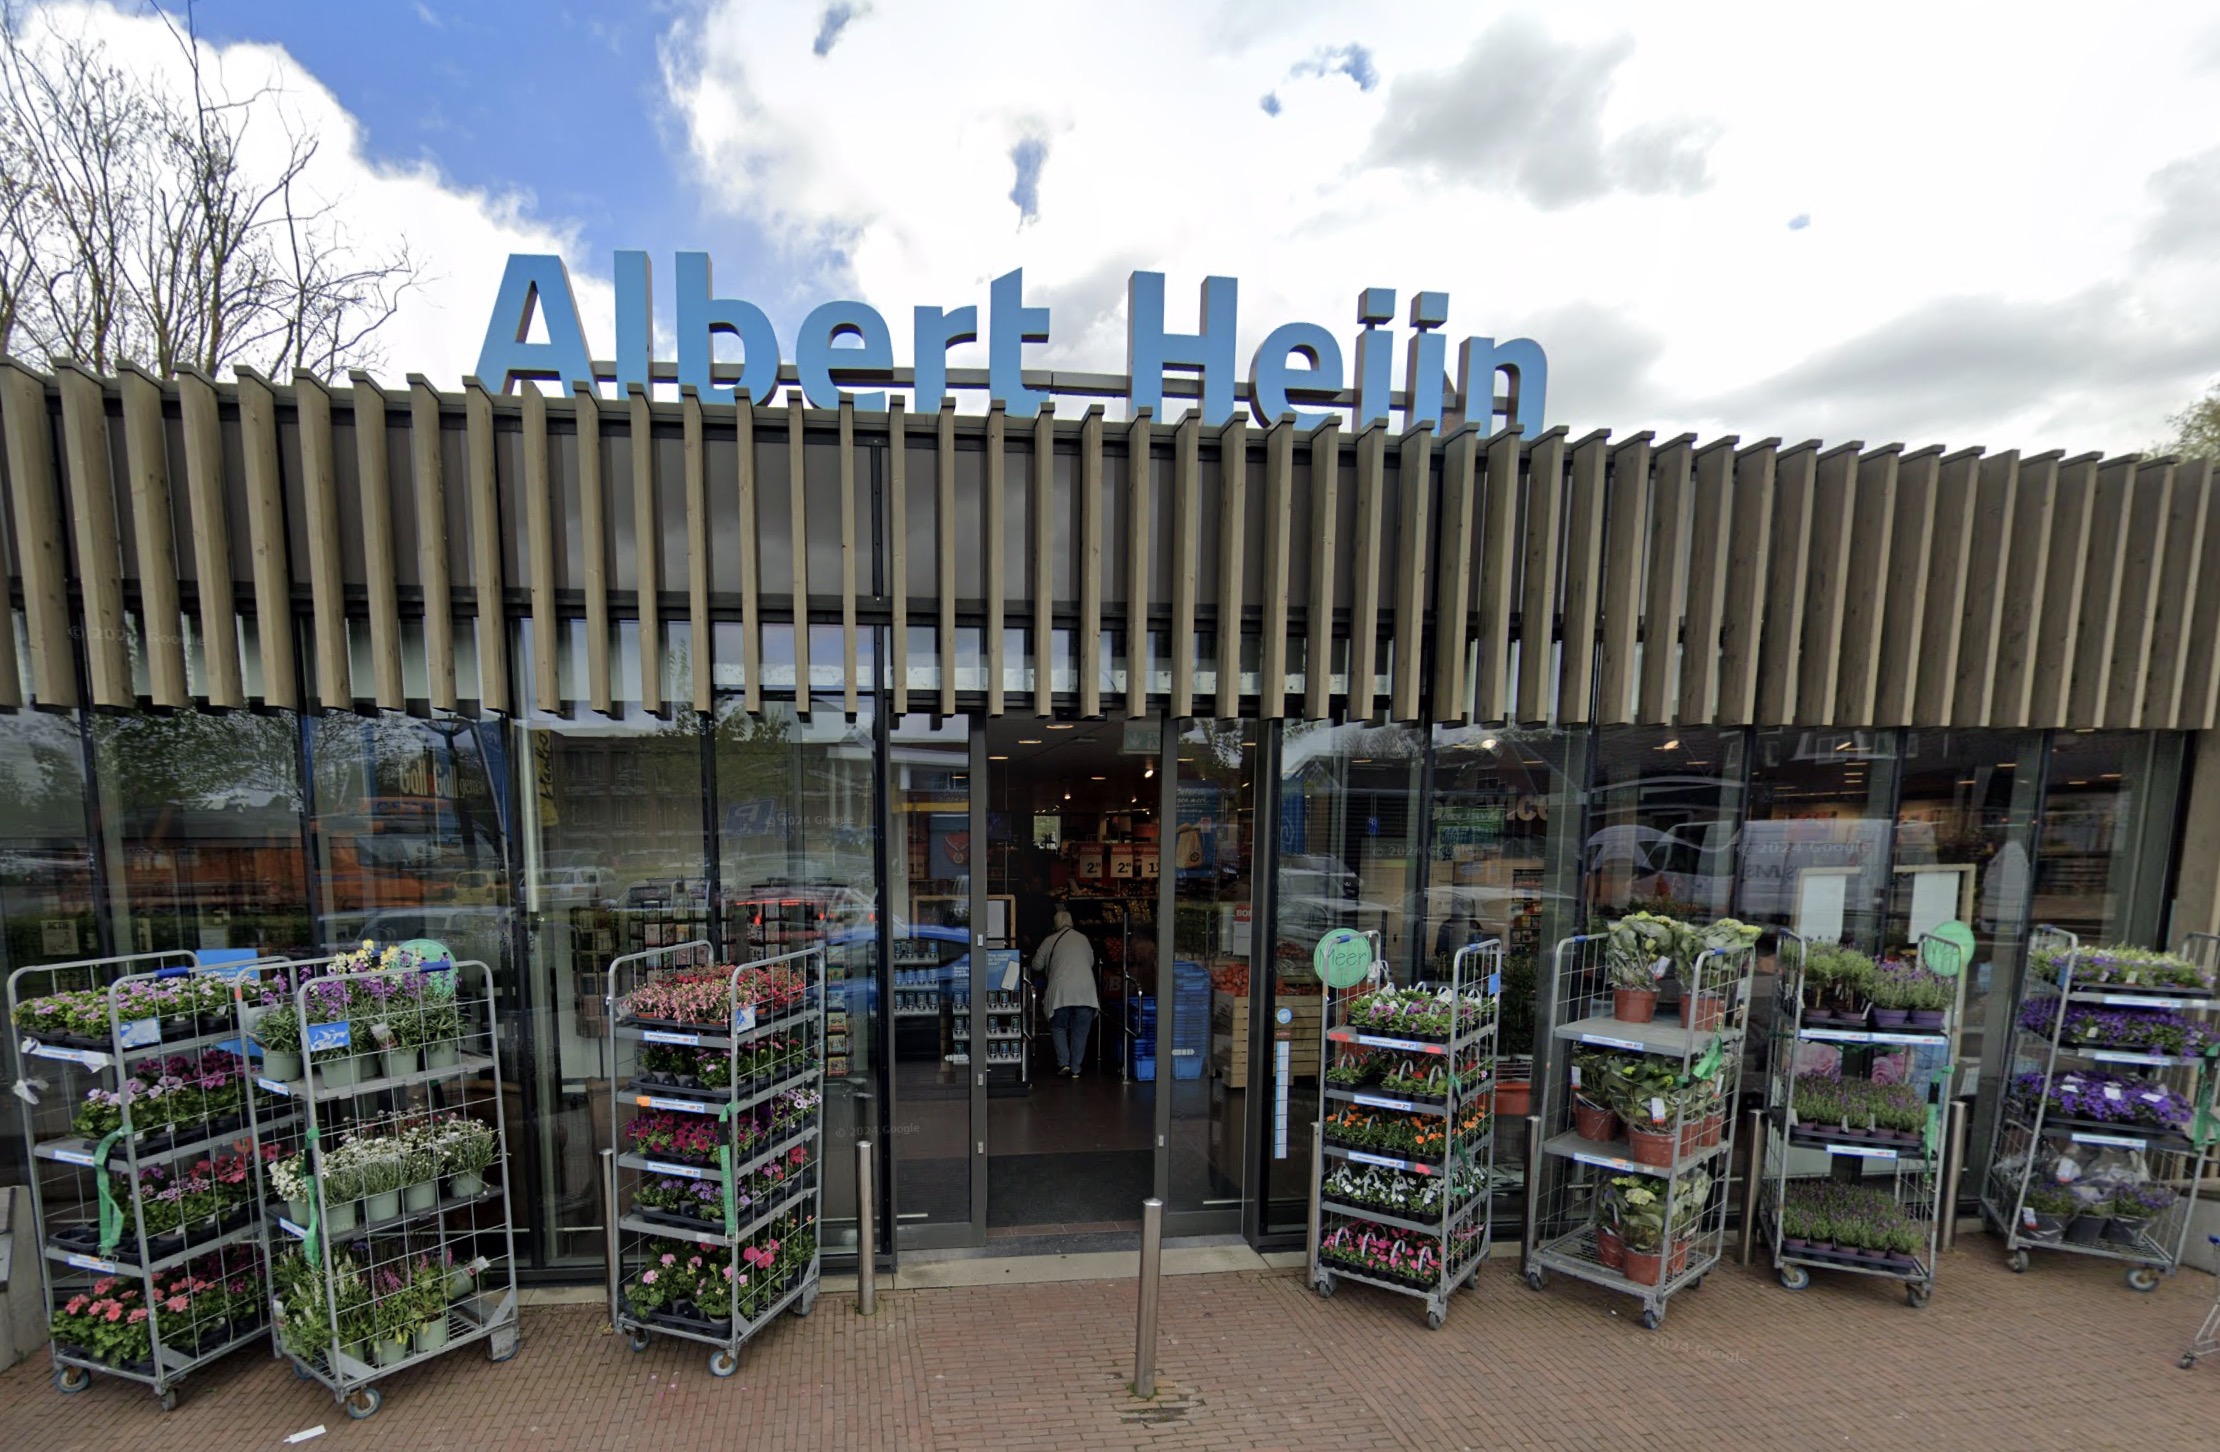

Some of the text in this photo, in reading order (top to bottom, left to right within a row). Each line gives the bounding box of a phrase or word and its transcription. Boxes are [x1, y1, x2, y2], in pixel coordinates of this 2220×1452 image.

[475, 249, 1549, 437] Albert Heijn
[1318, 946, 1368, 968] Meer
